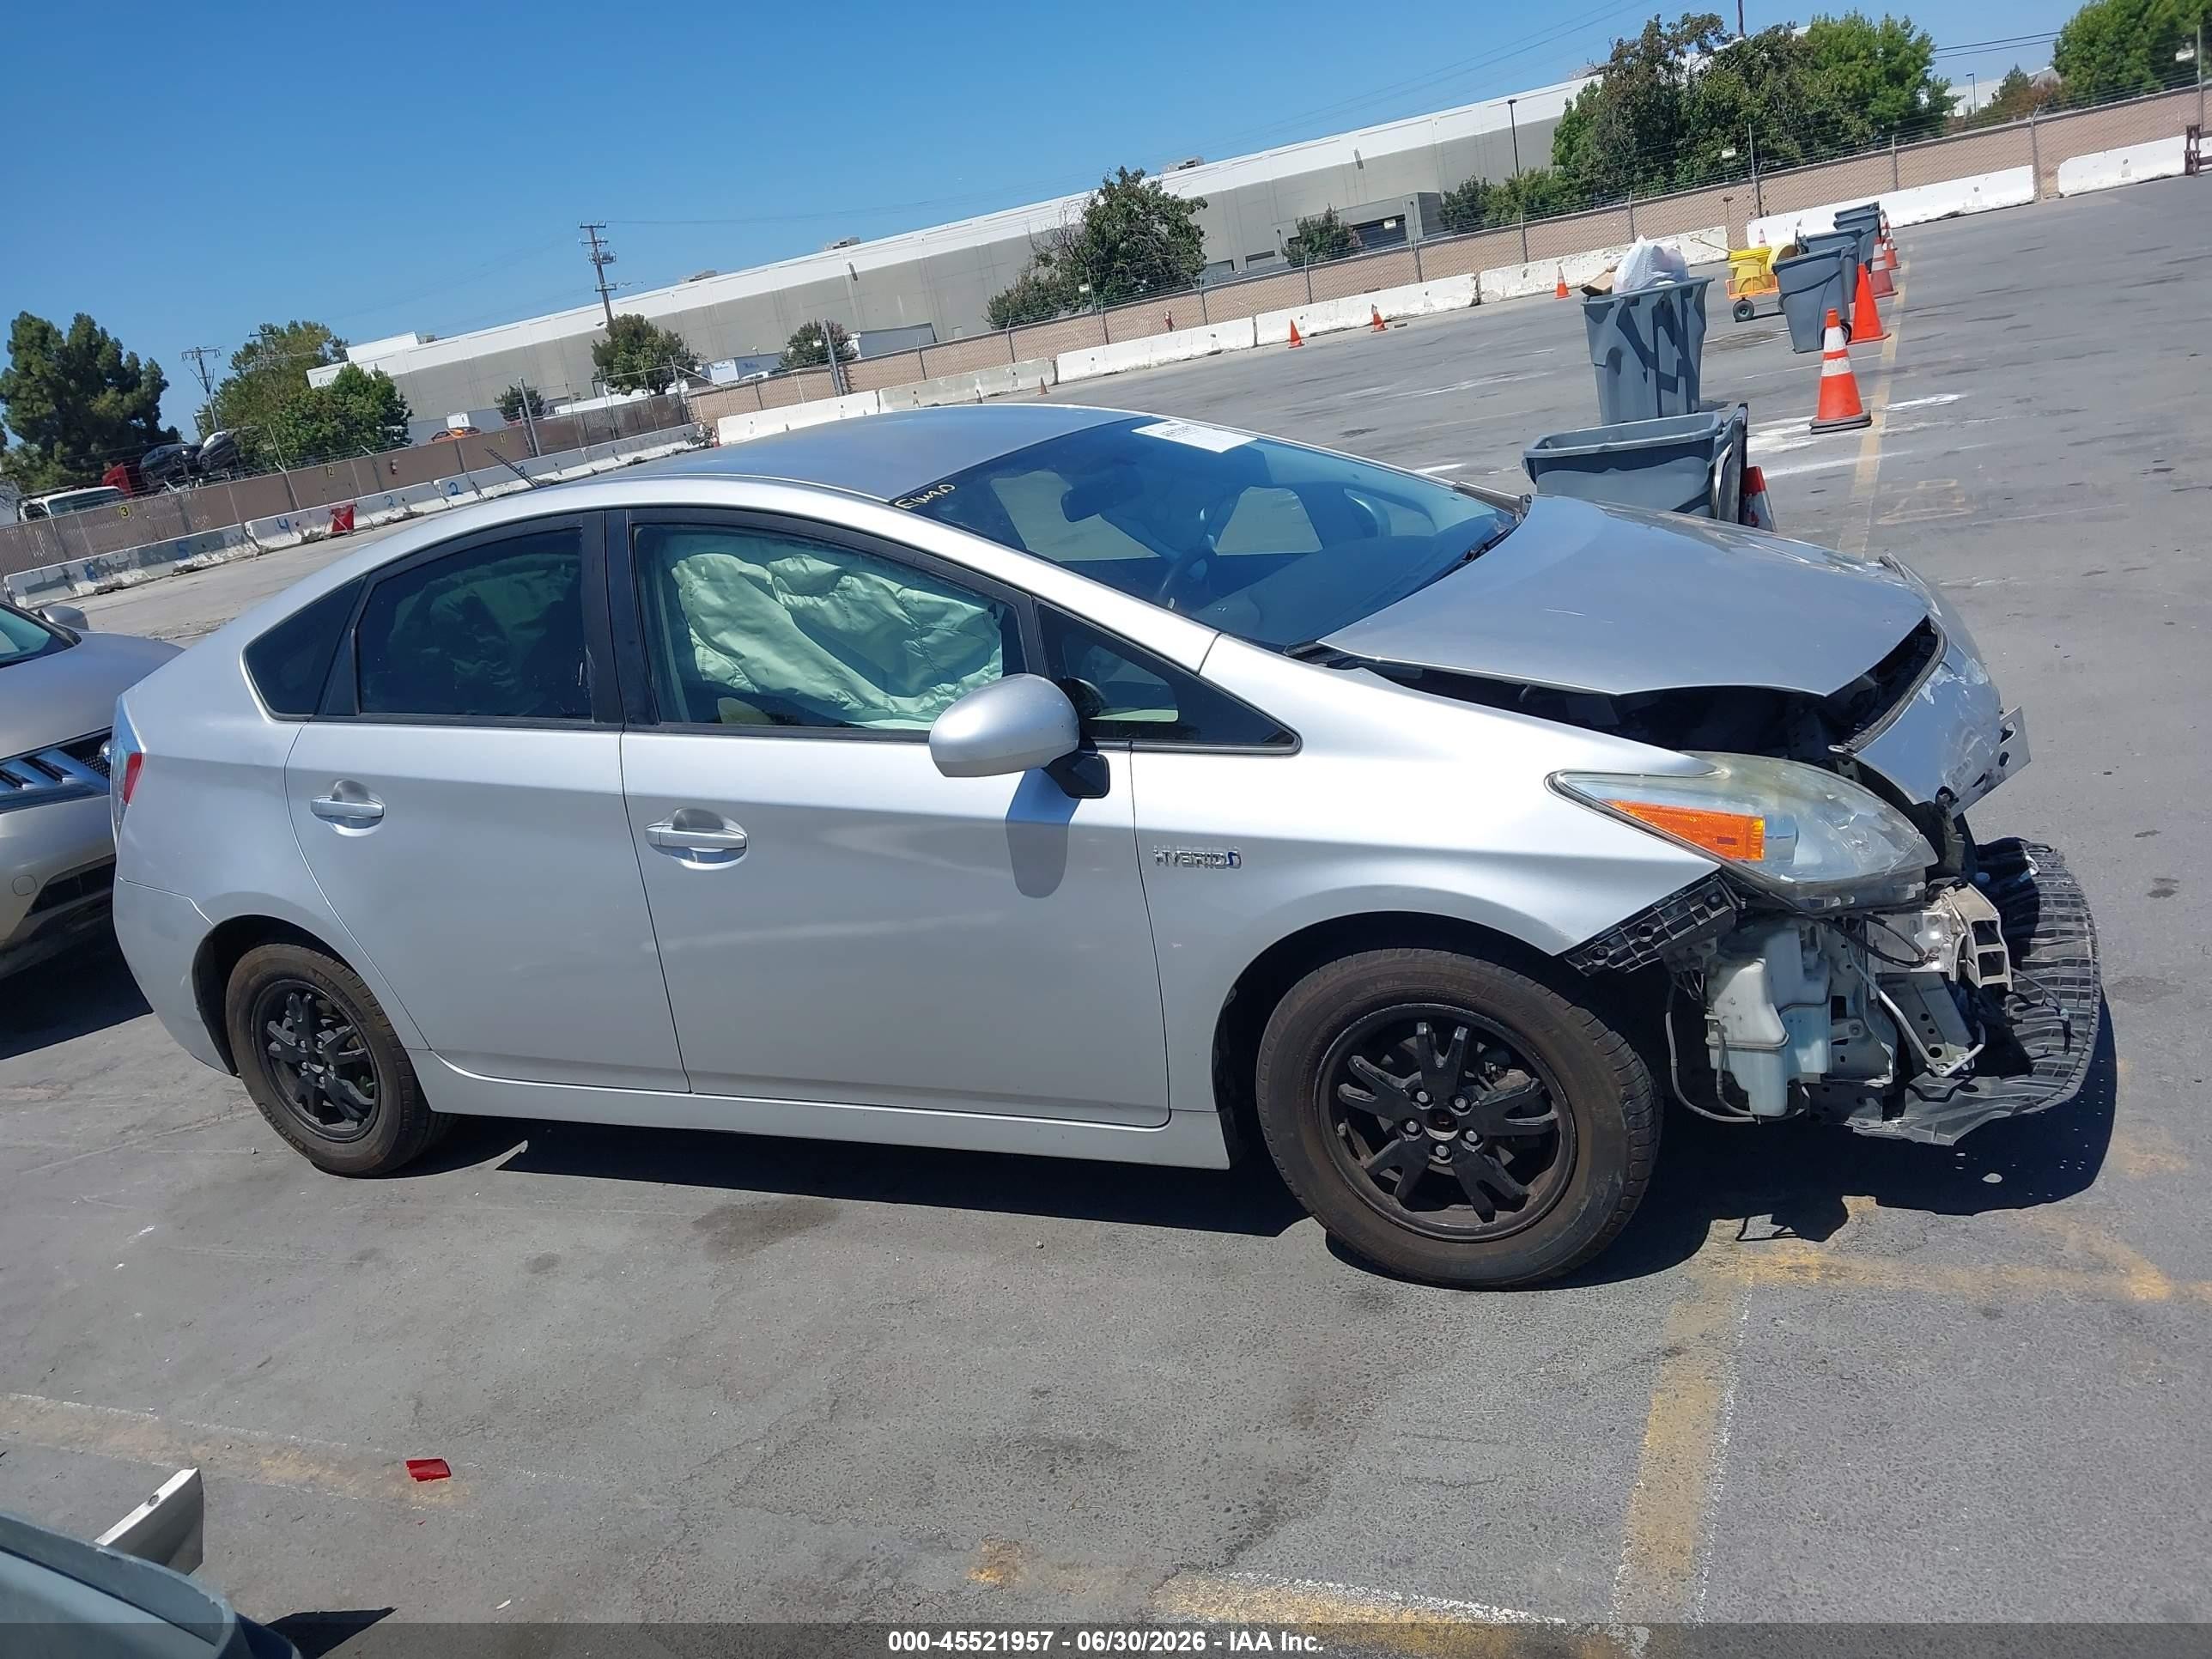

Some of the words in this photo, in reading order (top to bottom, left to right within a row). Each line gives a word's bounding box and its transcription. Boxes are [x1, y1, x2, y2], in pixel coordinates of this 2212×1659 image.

[448, 482, 463, 495] 2
[121, 507, 129, 517] 3
[276, 517, 294, 537] 4
[1152, 849, 1228, 869] HYBRID
